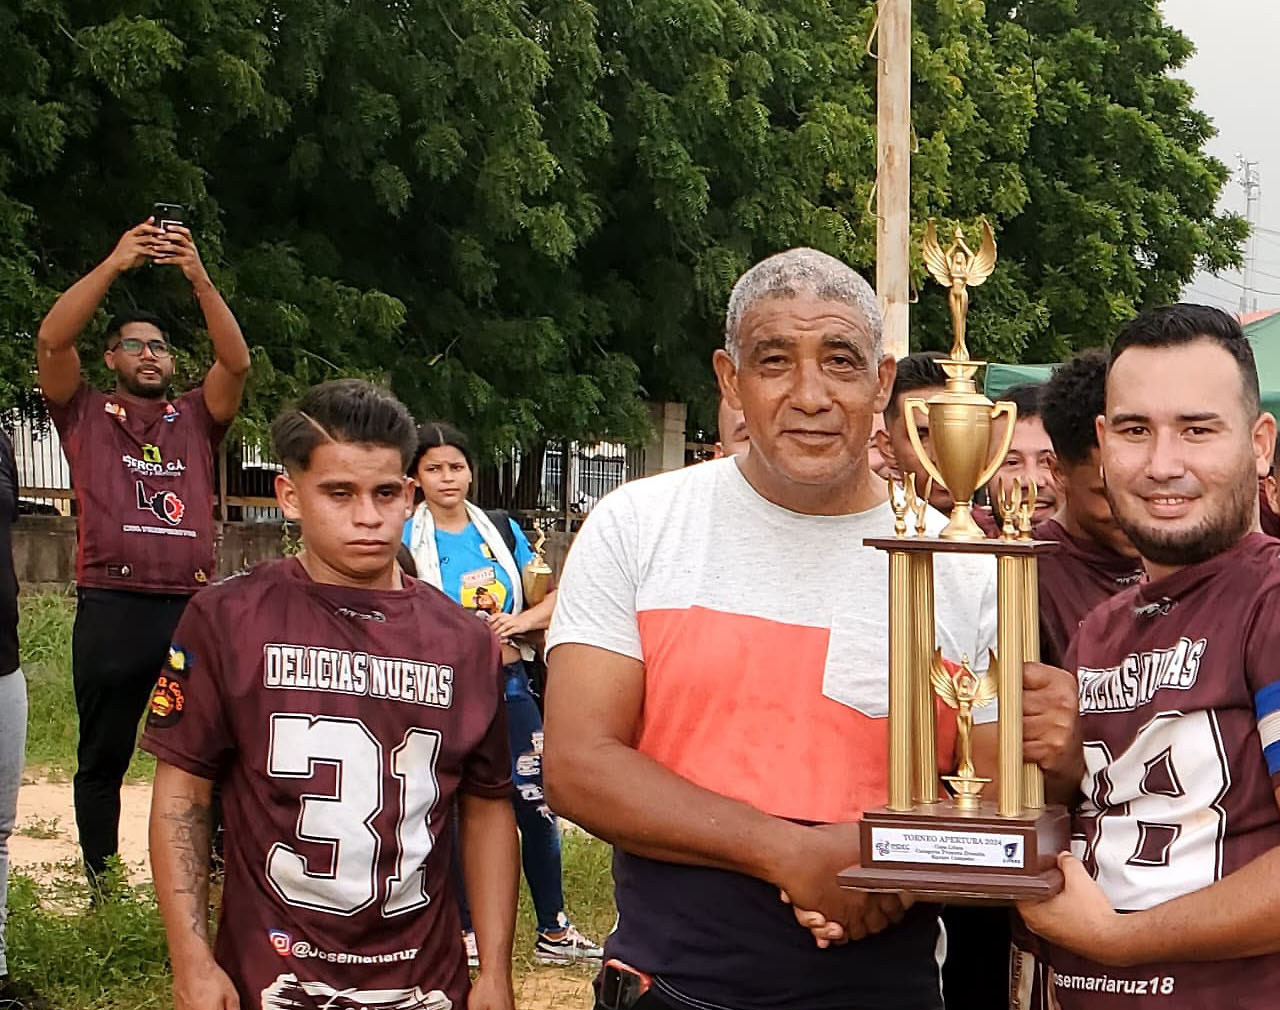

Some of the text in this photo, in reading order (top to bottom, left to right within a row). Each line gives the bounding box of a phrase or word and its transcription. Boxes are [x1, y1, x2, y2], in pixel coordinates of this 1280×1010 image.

[264, 643, 455, 709] DELICIAS NUEVAS
[265, 712, 443, 919] 31
[903, 833, 938, 843] TORNEO
[939, 835, 984, 846] APERTURA
